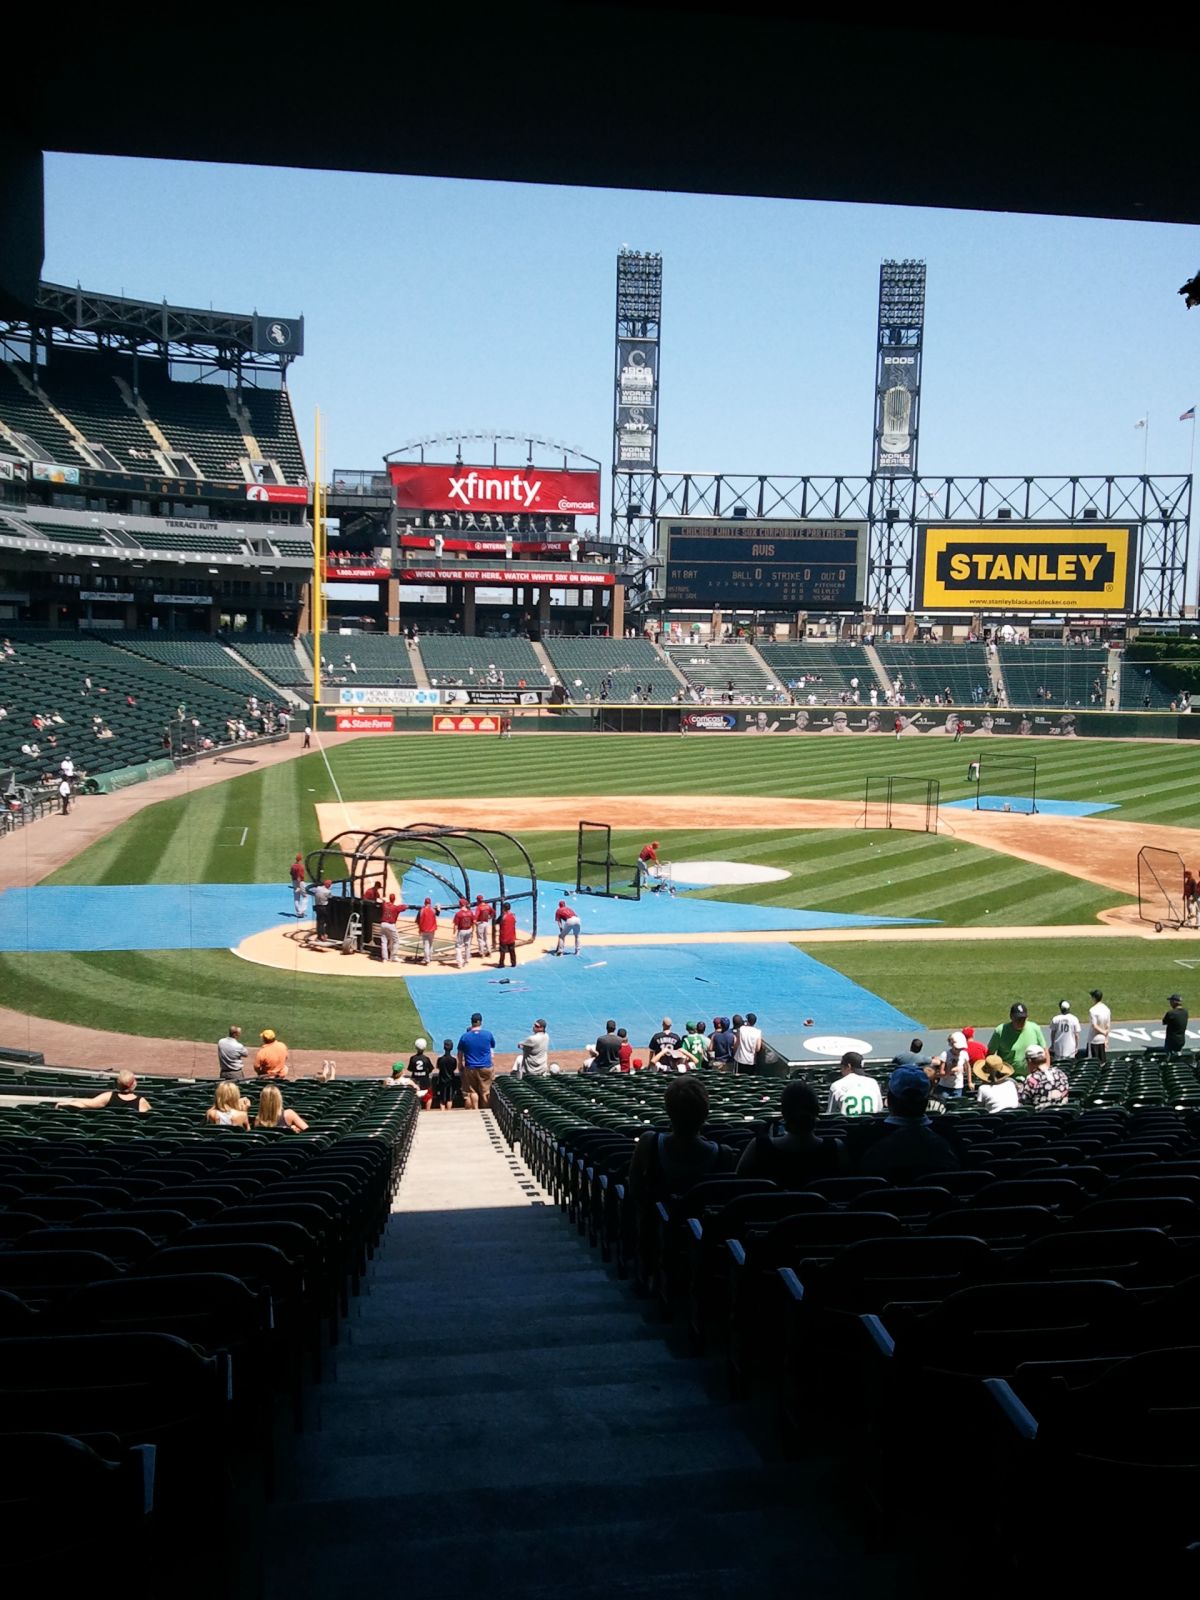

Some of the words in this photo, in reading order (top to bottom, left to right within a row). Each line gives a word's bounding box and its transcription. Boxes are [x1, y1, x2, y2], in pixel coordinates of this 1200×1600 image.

[884, 356, 915, 365] 2005
[624, 423, 649, 432] 1917
[448, 472, 541, 507] xfinity
[165, 520, 198, 529] TERRACE
[681, 527, 714, 537] CHICAGO
[716, 527, 740, 537] WHITE
[742, 528, 757, 537] SOX
[760, 528, 805, 537] CORPORATE
[806, 529, 846, 538] PARTNERS
[751, 544, 775, 557] AVIS
[949, 553, 1103, 581] STANLEY
[437, 571, 463, 579] YOU'RE
[481, 572, 502, 580] HERE,
[580, 575, 605, 583] DEMAND
[671, 570, 682, 579] AT
[683, 570, 698, 579] BAT
[732, 571, 752, 580] BALL
[755, 568, 762, 580] 0
[771, 572, 801, 580] STRIKE
[804, 568, 811, 580] 0
[820, 572, 836, 581] OUT
[838, 569, 846, 581] 0
[1060, 1023, 1070, 1033] 10
[415, 1060, 424, 1071] 2
[844, 1096, 875, 1117] 20
